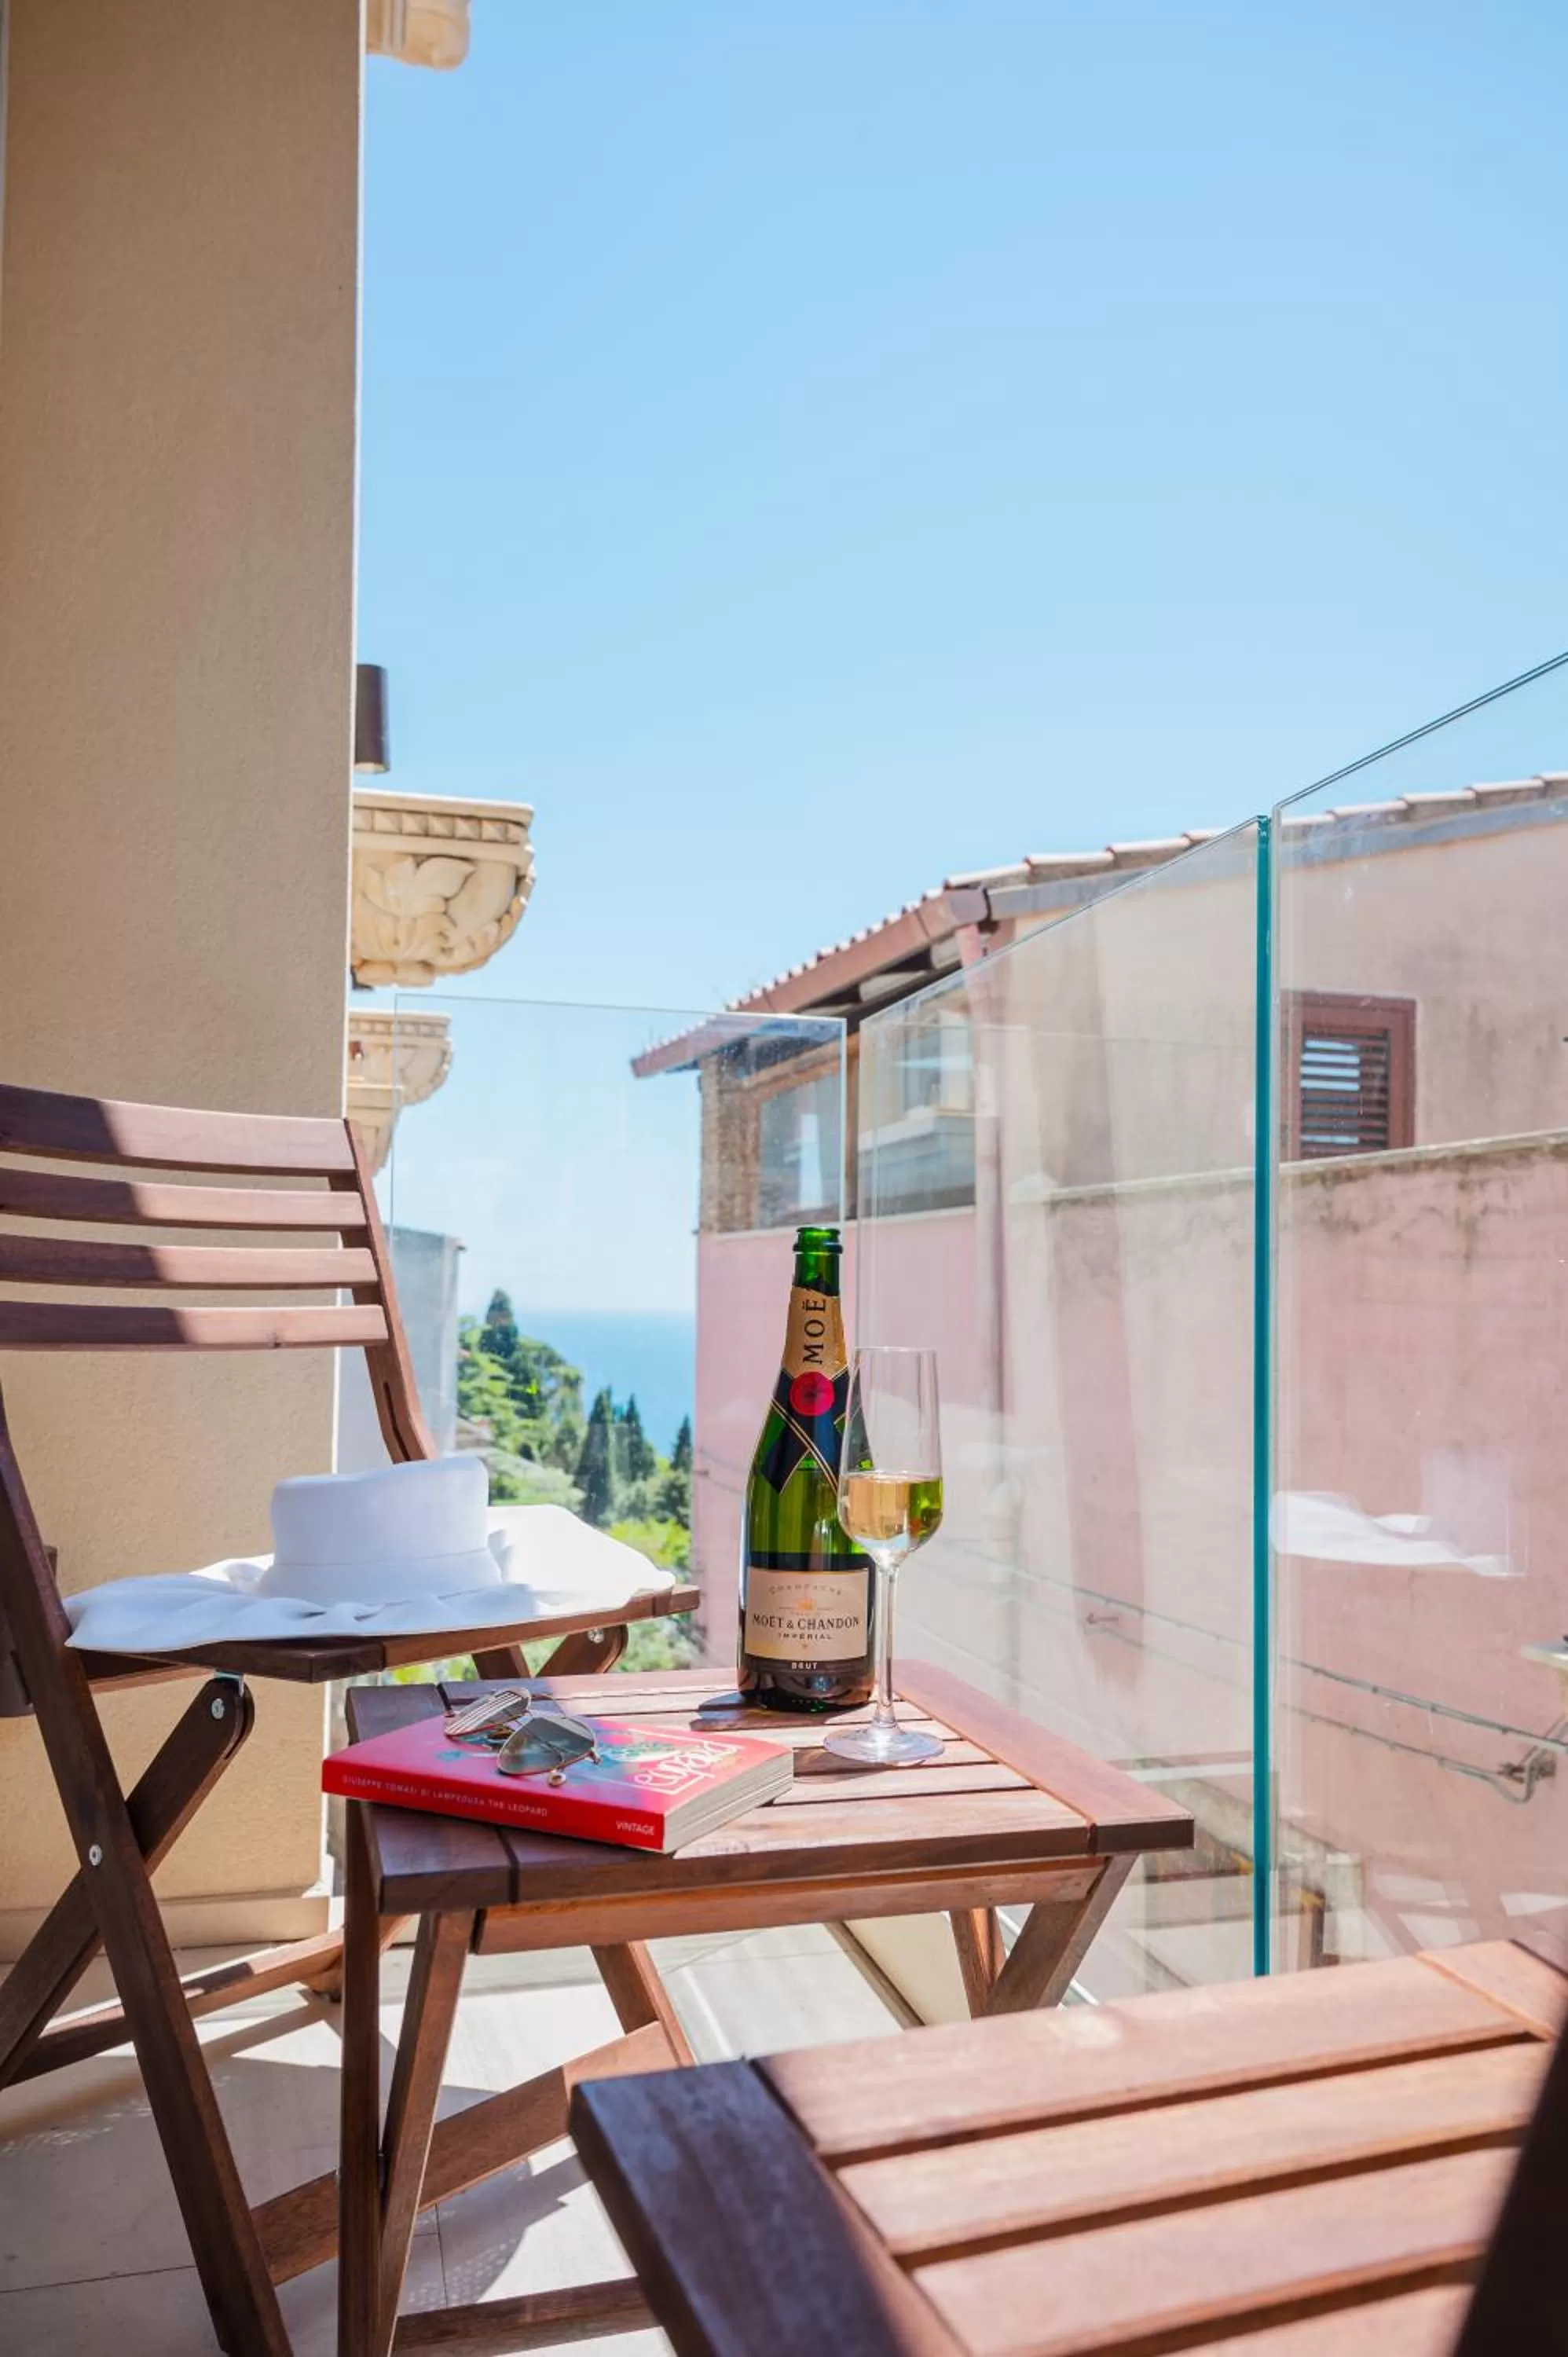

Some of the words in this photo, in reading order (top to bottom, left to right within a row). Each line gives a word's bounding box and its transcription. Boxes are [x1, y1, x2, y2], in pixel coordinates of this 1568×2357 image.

[802, 1297, 826, 1365] MOË
[786, 1619, 794, 1629] &
[797, 1615, 859, 1630] CHANDON
[791, 1662, 818, 1670] BRUT
[489, 1798, 504, 1809] THE
[508, 1802, 548, 1817] LEOPARD
[615, 1820, 655, 1836] VINTAGE
